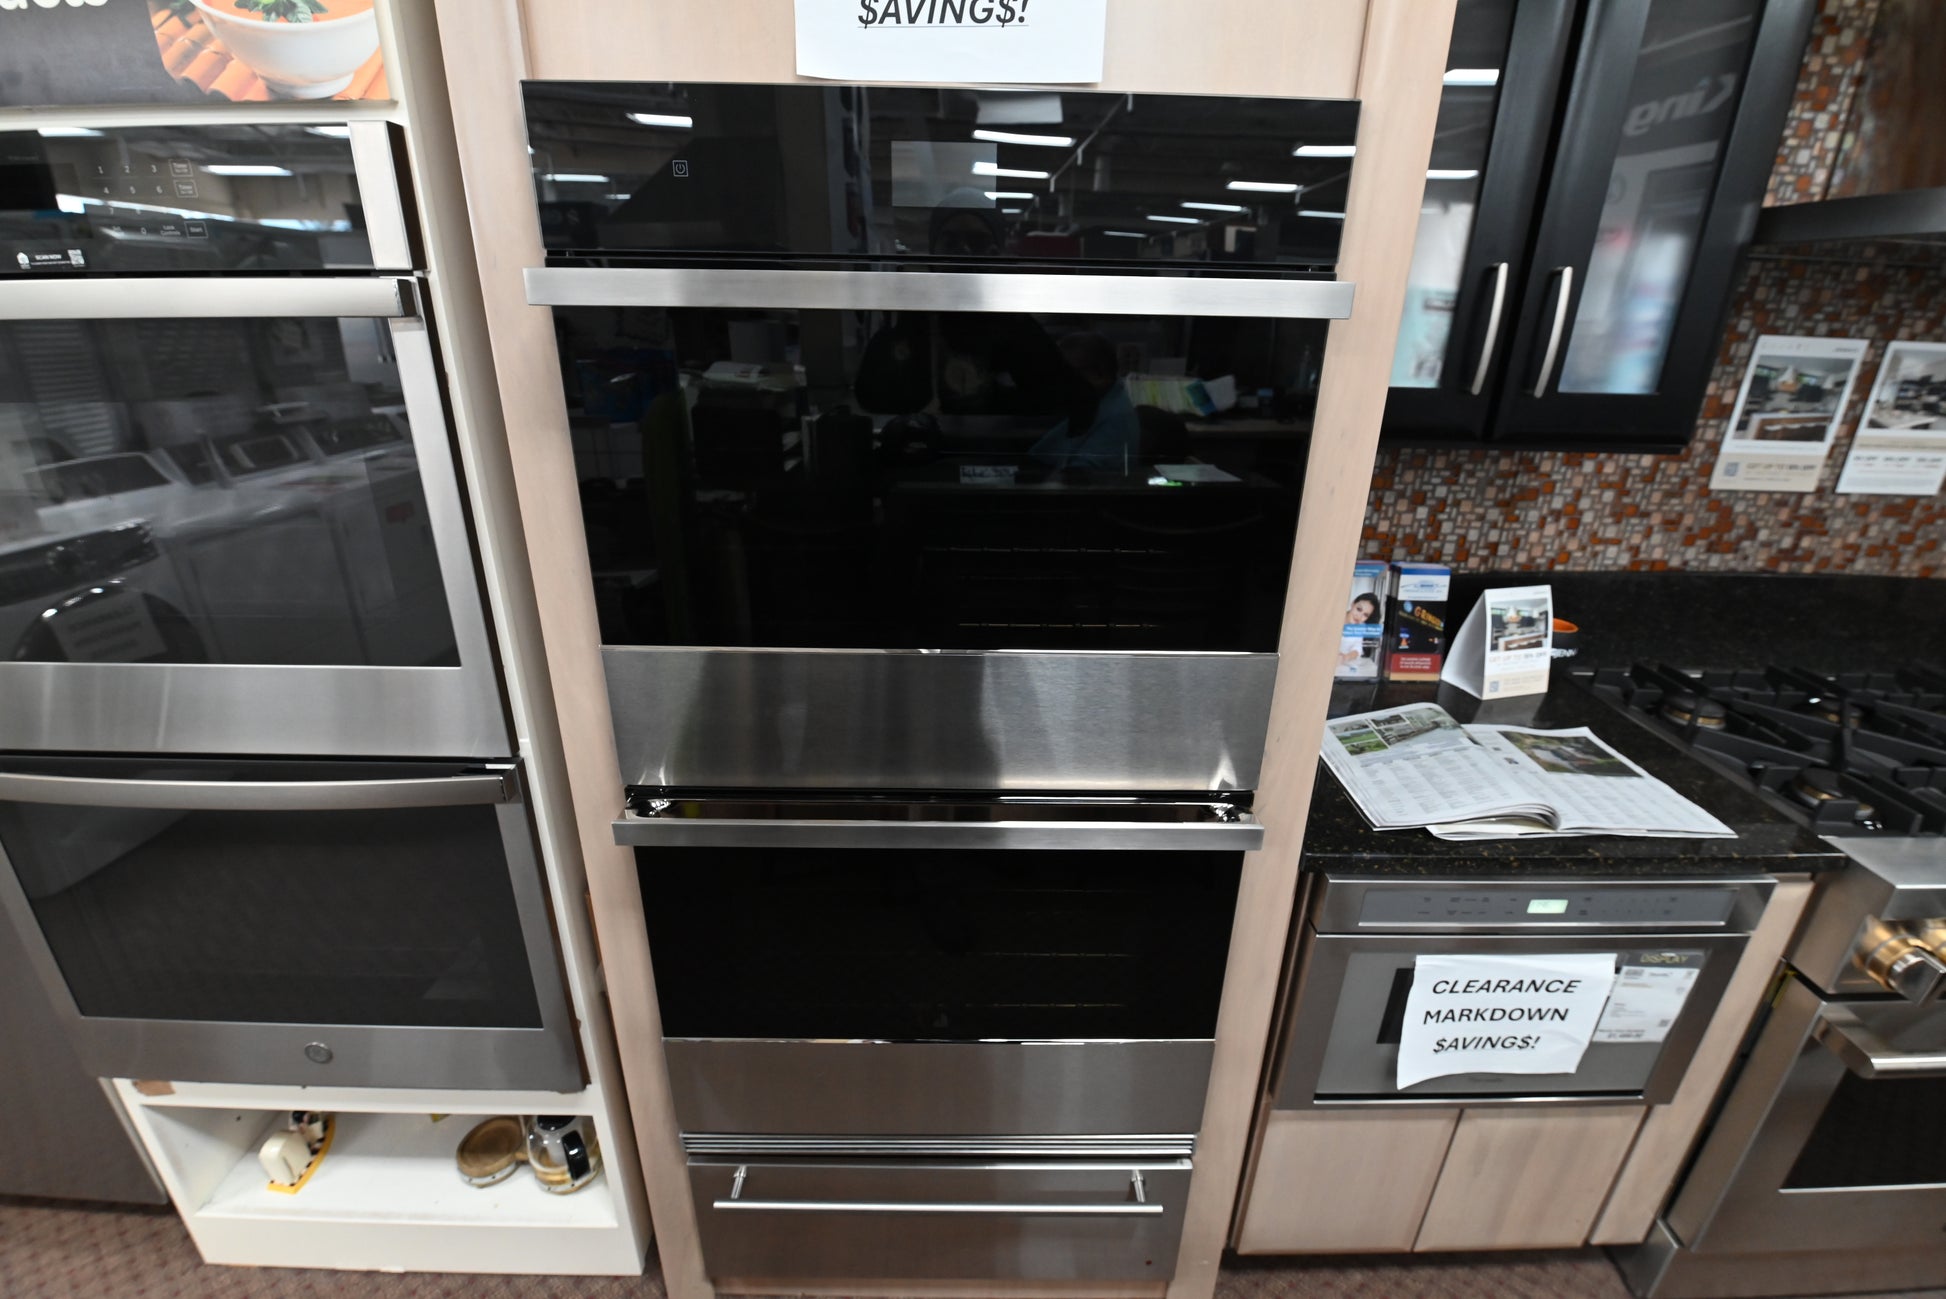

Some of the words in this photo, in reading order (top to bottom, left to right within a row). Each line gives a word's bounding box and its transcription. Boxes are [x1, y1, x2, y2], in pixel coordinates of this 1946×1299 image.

[1432, 979, 1581, 994] CLEARANCE
[1423, 1008, 1569, 1025] MARKDOWN
[1433, 1034, 1541, 1054] $AVING$!
